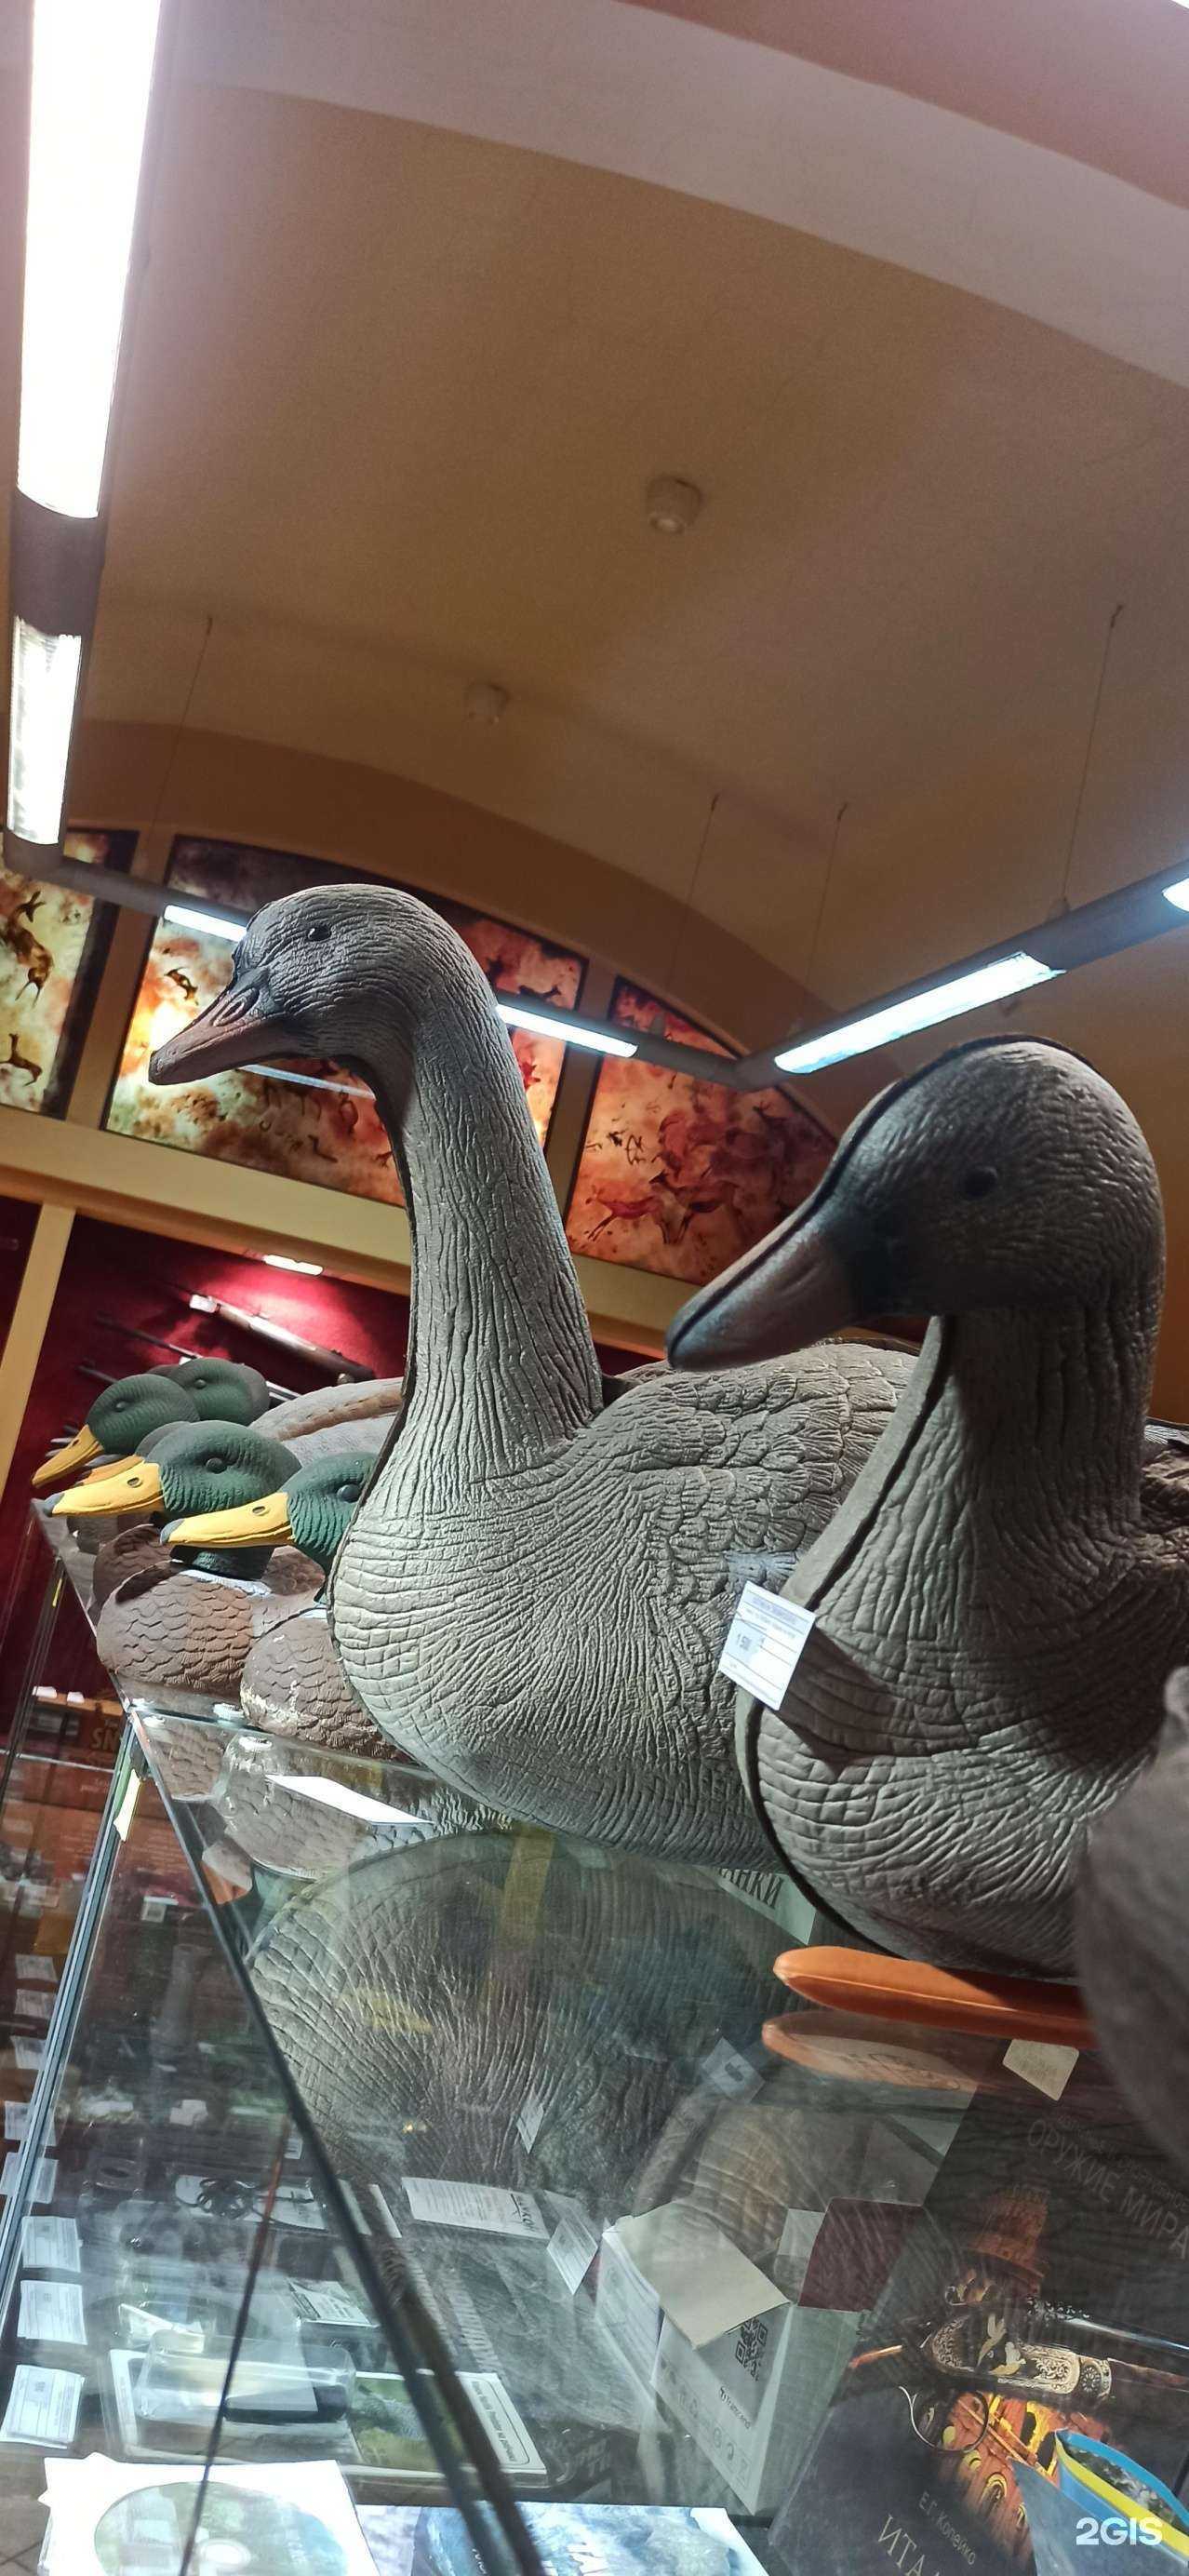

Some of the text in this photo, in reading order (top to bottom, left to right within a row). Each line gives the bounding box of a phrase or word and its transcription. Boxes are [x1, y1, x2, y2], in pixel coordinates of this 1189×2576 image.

[1027, 2119, 1120, 2204] ОРУЖИЕ
[1118, 2185, 1189, 2260] МИРА
[878, 2514, 940, 2576] ИТА
